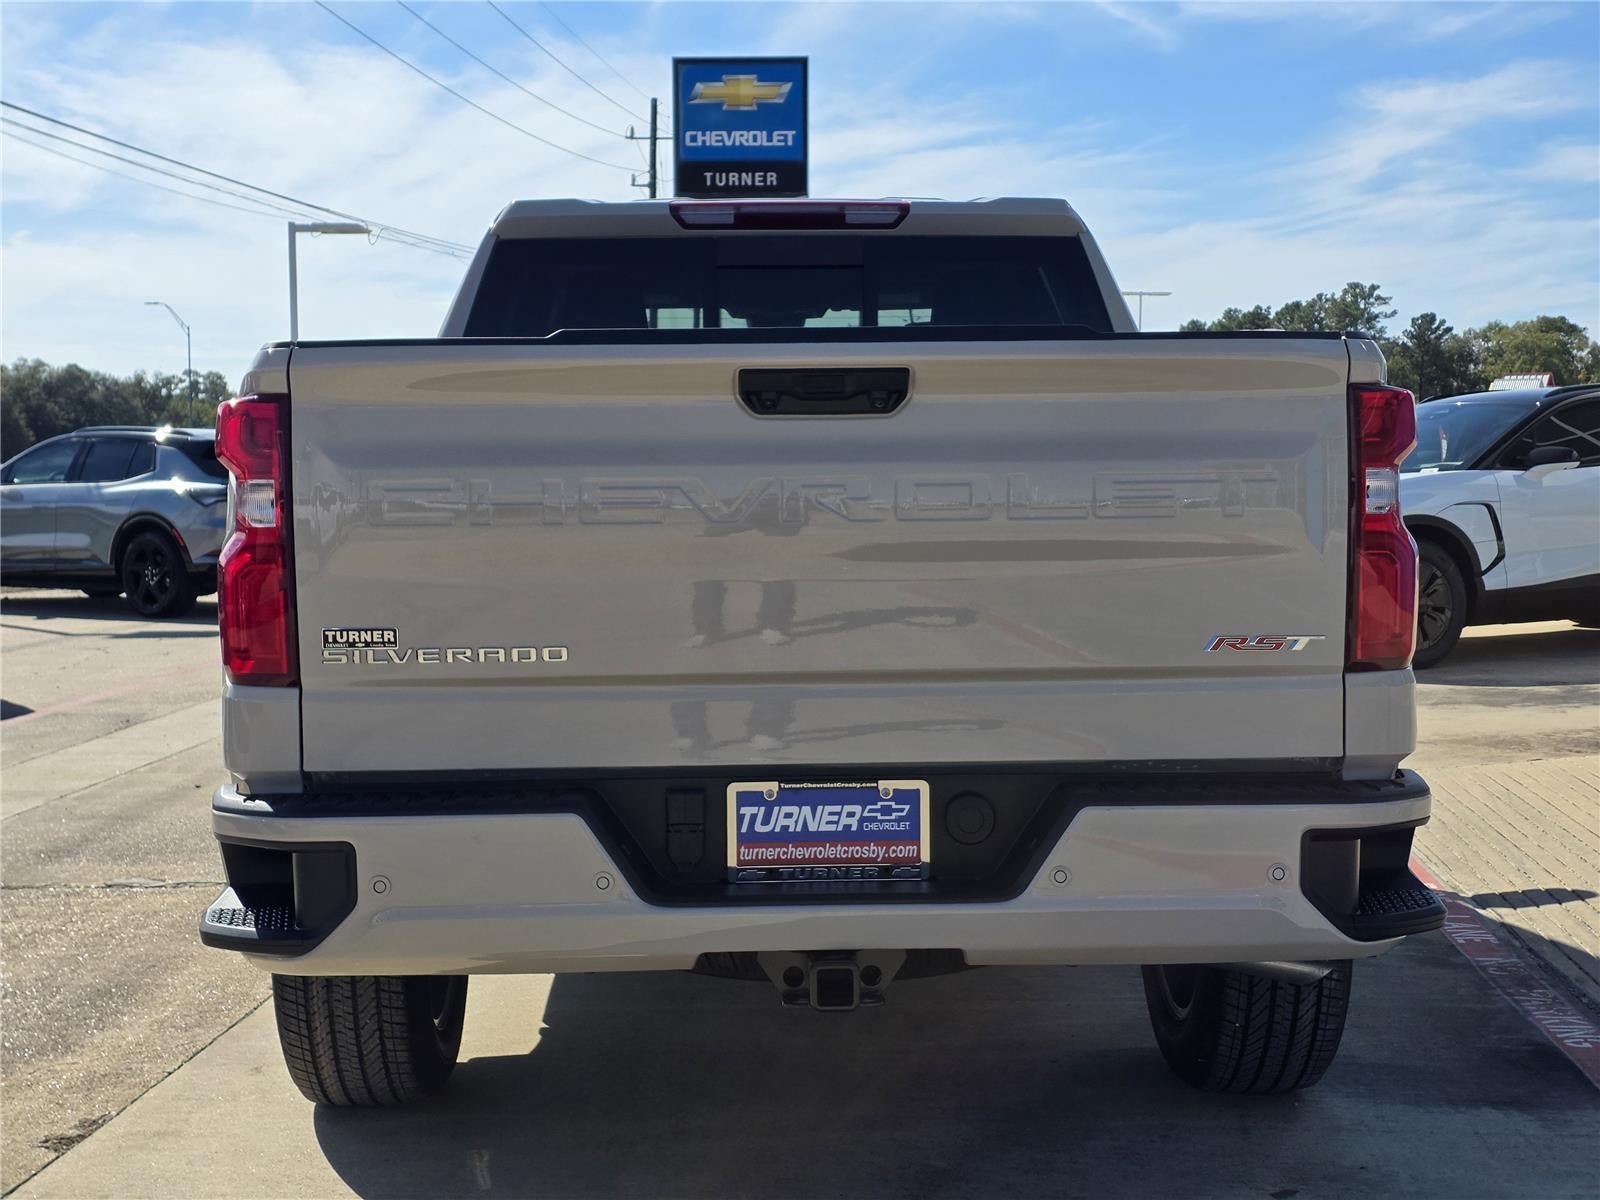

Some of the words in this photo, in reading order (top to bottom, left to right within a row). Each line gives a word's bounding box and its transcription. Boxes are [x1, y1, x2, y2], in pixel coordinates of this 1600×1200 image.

[685, 130, 796, 147] CHEVROLET
[704, 172, 777, 186] TURNER
[367, 472, 1278, 526] CHEVROLET
[325, 630, 395, 642] TURNER
[1204, 633, 1326, 652] RST
[322, 647, 568, 664] SILVERADO
[740, 805, 862, 832] TURNER
[863, 822, 910, 831] CHEVROLET
[740, 843, 917, 861] turnerchevroletcrosby.com
[779, 867, 880, 879] TURNER
